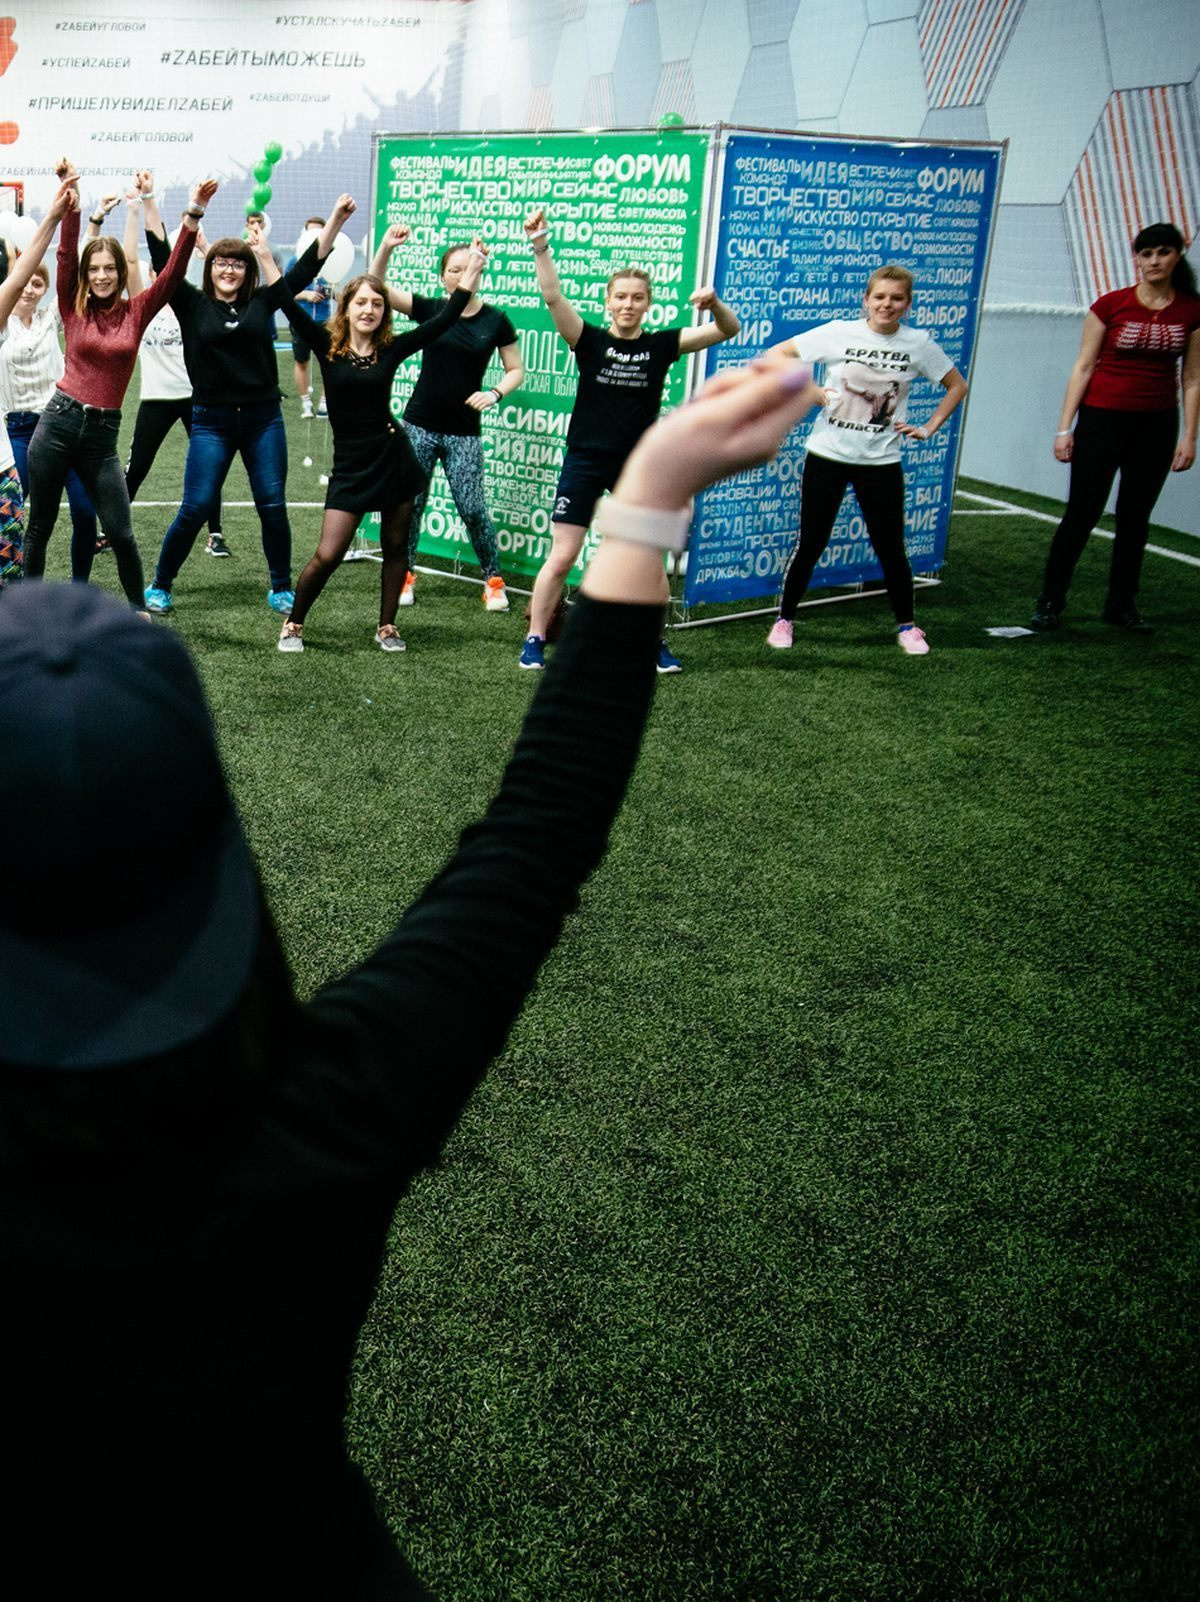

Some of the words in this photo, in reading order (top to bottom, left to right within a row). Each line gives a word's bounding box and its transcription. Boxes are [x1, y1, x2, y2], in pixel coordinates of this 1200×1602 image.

[161, 48, 366, 68] #ZАБЕЙТЫМОЖЕШЬ
[390, 156, 455, 170] ФЕСТИВАЛЬ
[455, 156, 507, 180] ИДЕЯ
[508, 156, 570, 170] ВСТРЕЧИ
[593, 154, 691, 187] ФОРУМ
[735, 156, 801, 174] ФЕСТИВАЛЬ
[801, 160, 848, 186] ИДЕЯ
[849, 164, 900, 179] ВСТРЕЧИ
[917, 166, 985, 197] ФОРУМ
[389, 181, 510, 200] ТВОРЧЕСТВО
[512, 179, 552, 198] МИР
[553, 178, 618, 198] СЕЙЧАС
[619, 187, 689, 204] ЛЮБОВЬ
[733, 185, 850, 208] ТВОРЧЕСТВО
[852, 188, 884, 206] МИР
[885, 189, 935, 208] СЕЙЧАС
[935, 198, 981, 213] ЛЮБОВЬ
[420, 199, 450, 212] МИР
[451, 200, 522, 217] ИСКУССТВО
[619, 207, 644, 218] СВЕТ
[644, 208, 686, 220] КРАСОТА
[764, 206, 794, 222] МИР
[794, 209, 859, 226] ИСКУССТВО
[861, 211, 933, 228] ОТКРЫТИЕ
[387, 213, 438, 226] КОМАНДА
[623, 222, 686, 235] МОЛОДЕЖЬ
[592, 234, 682, 250] ВОЗМОЖНОСТИ
[729, 222, 781, 237] КОМАНДА
[824, 230, 913, 252] ОБЩЕСТВО
[611, 249, 683, 262] ПУТЕШЕСТВИЯ
[727, 238, 790, 258] СЧАСТЬЕ
[912, 243, 974, 255] ВОЗМОЖНОСТИ
[556, 259, 588, 276] ИЗНЬ
[729, 259, 779, 271] ГОРИЗОНТ
[791, 253, 821, 264] ТАЛАНТ
[823, 254, 843, 265] МИР
[844, 253, 882, 266] ЮНОСТЬ
[725, 270, 780, 286] ПАТРИОТ
[785, 273, 799, 283] ИЗ
[842, 272, 866, 283] ЛЕТО
[935, 268, 972, 286] ЛЮДИ
[723, 286, 778, 301] ЮНОСТЬ
[779, 287, 830, 305] СТРАНА
[781, 308, 861, 320] НОВОСИБИРСКА
[916, 305, 967, 326] ВЫБОР
[845, 347, 912, 363] БРАТВА
[554, 376, 577, 396] ОБЛА
[526, 443, 564, 467] ДИА
[907, 448, 948, 465] ТАЛАНТ
[484, 475, 539, 495] ВИЖЕНИЕ
[703, 484, 776, 503] ИННОВАЦИИ
[499, 488, 539, 506] РАБОТА
[703, 501, 759, 516] РЕЗУЛЬТАТ
[759, 499, 781, 512] МИР
[700, 512, 789, 538] СТУДЕНТЫ
[698, 550, 743, 566] ЧЕЛОВЕК
[695, 565, 740, 584] ДРУЖБА
